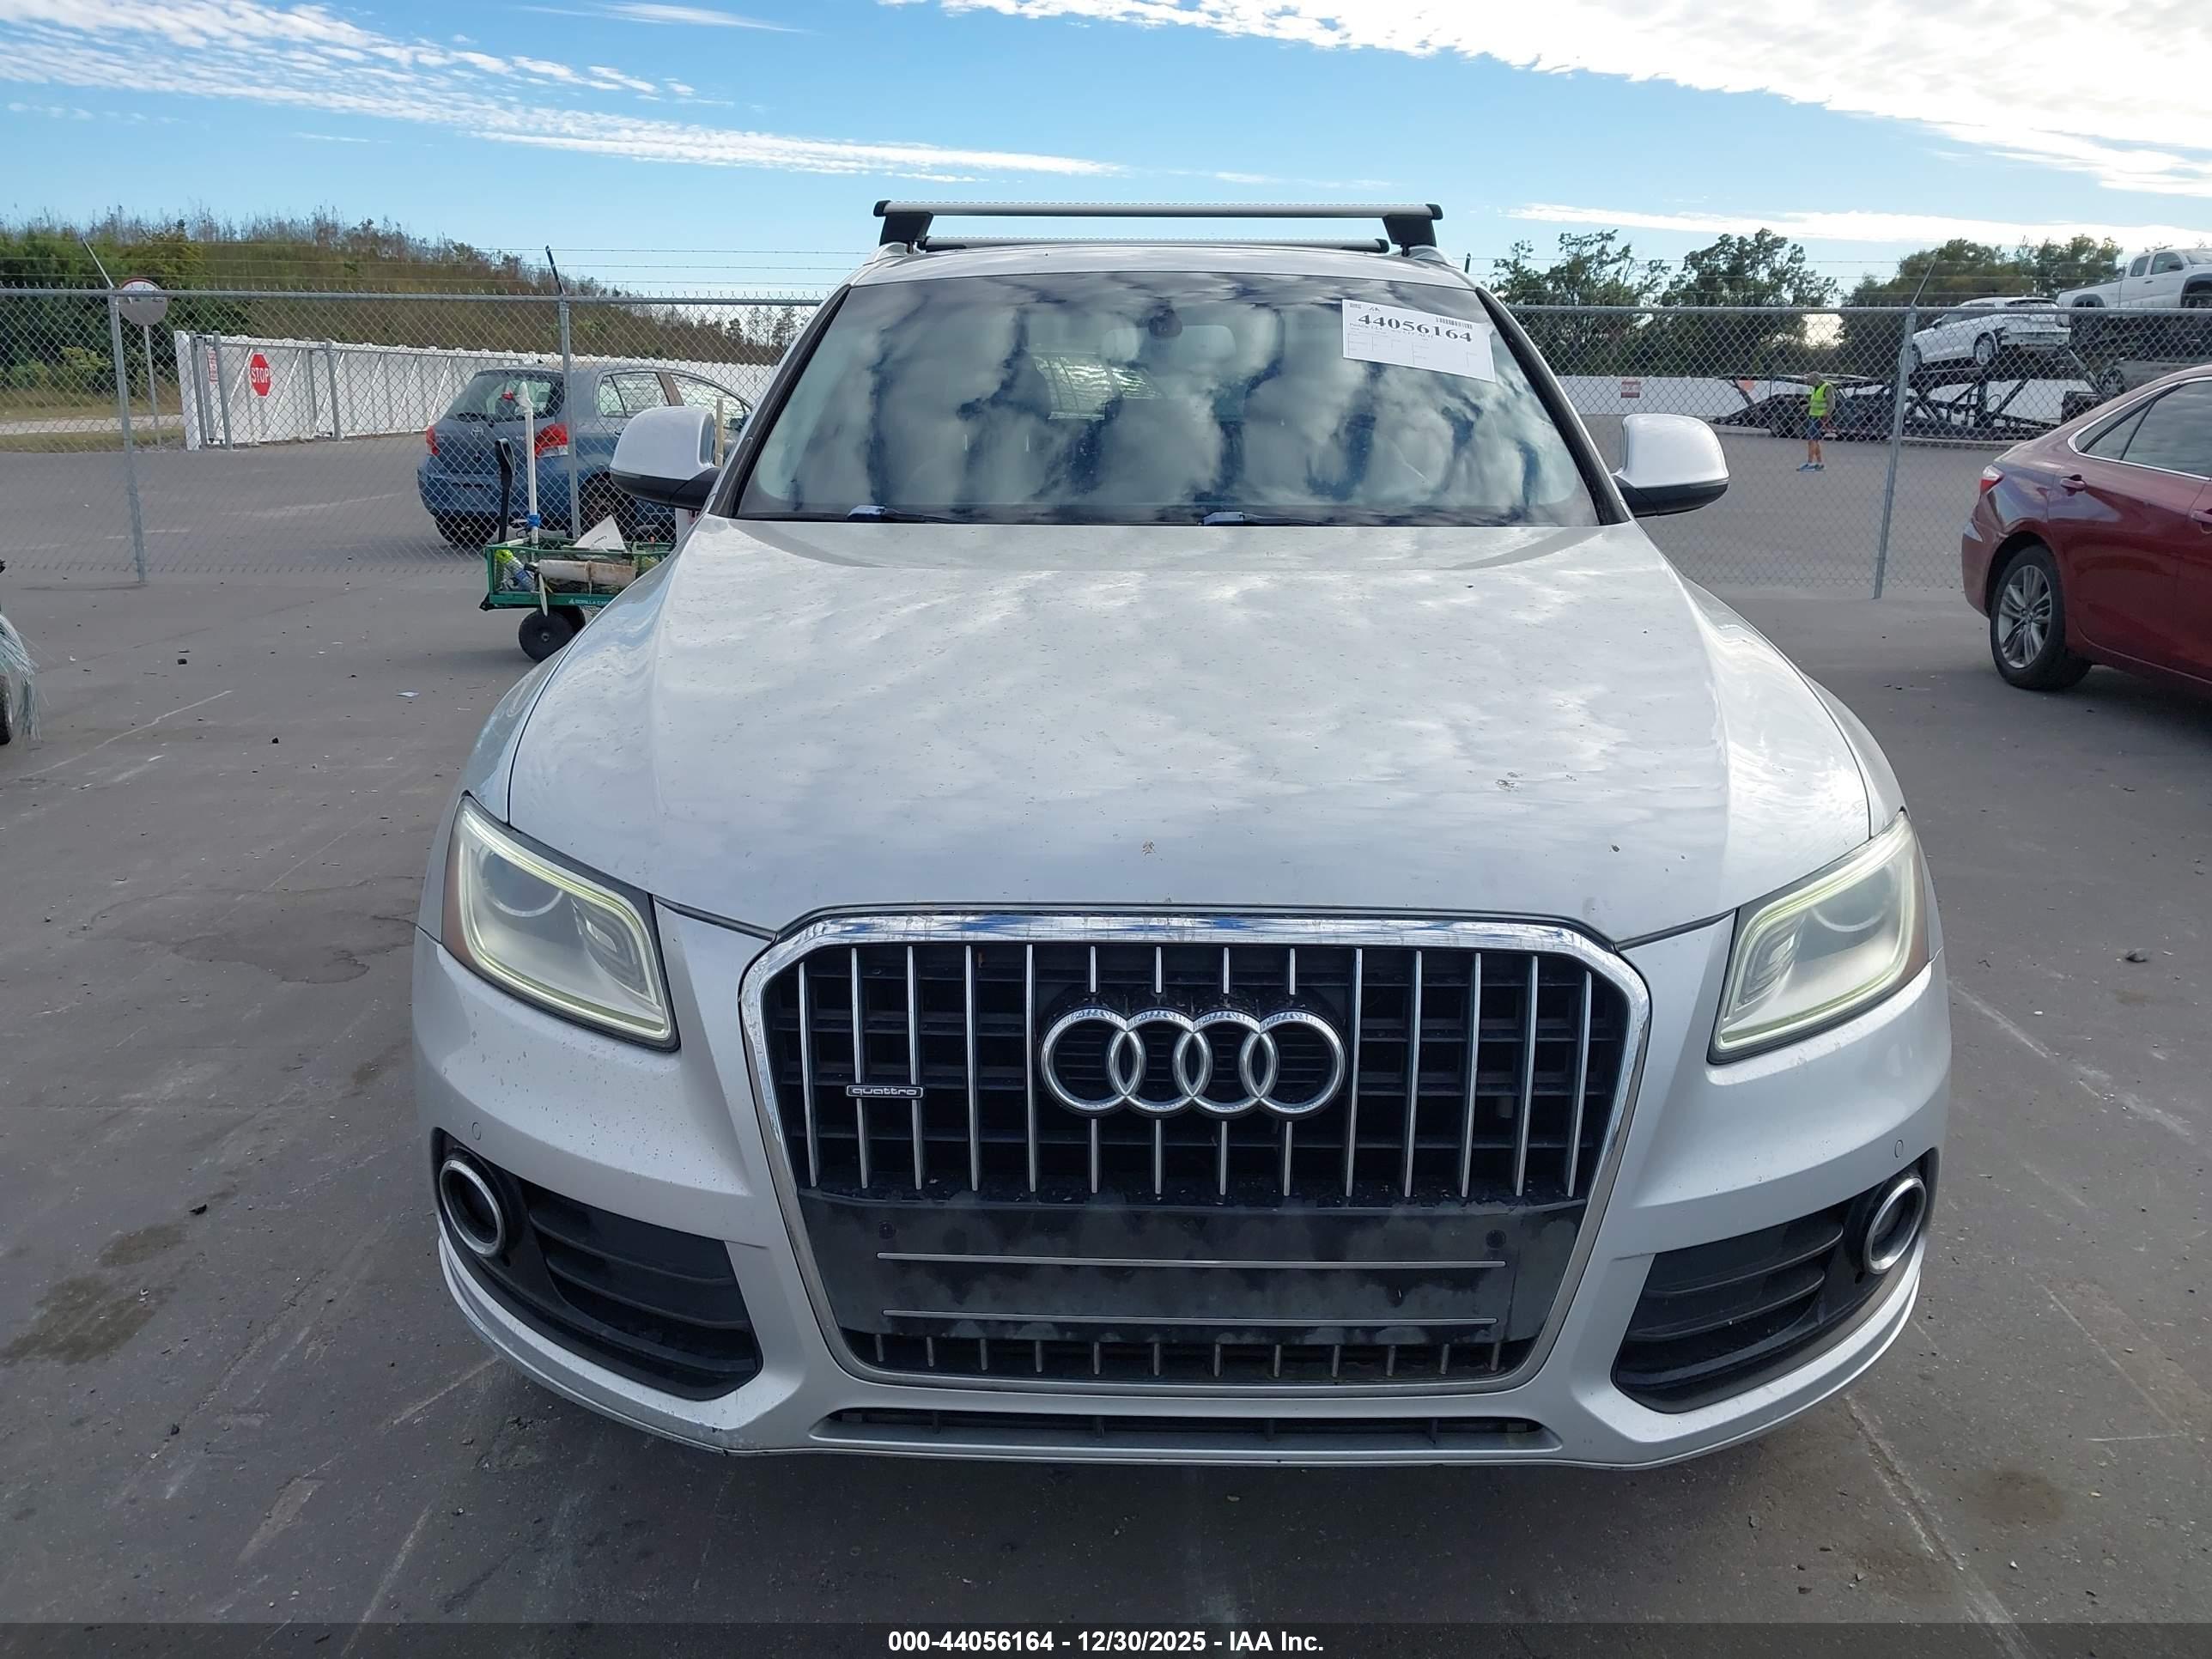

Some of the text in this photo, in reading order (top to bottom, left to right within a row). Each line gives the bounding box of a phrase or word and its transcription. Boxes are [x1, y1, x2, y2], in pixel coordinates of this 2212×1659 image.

[1358, 313, 1473, 343] 44056164
[251, 367, 270, 384] STOP
[852, 1087, 917, 1096] quattro
